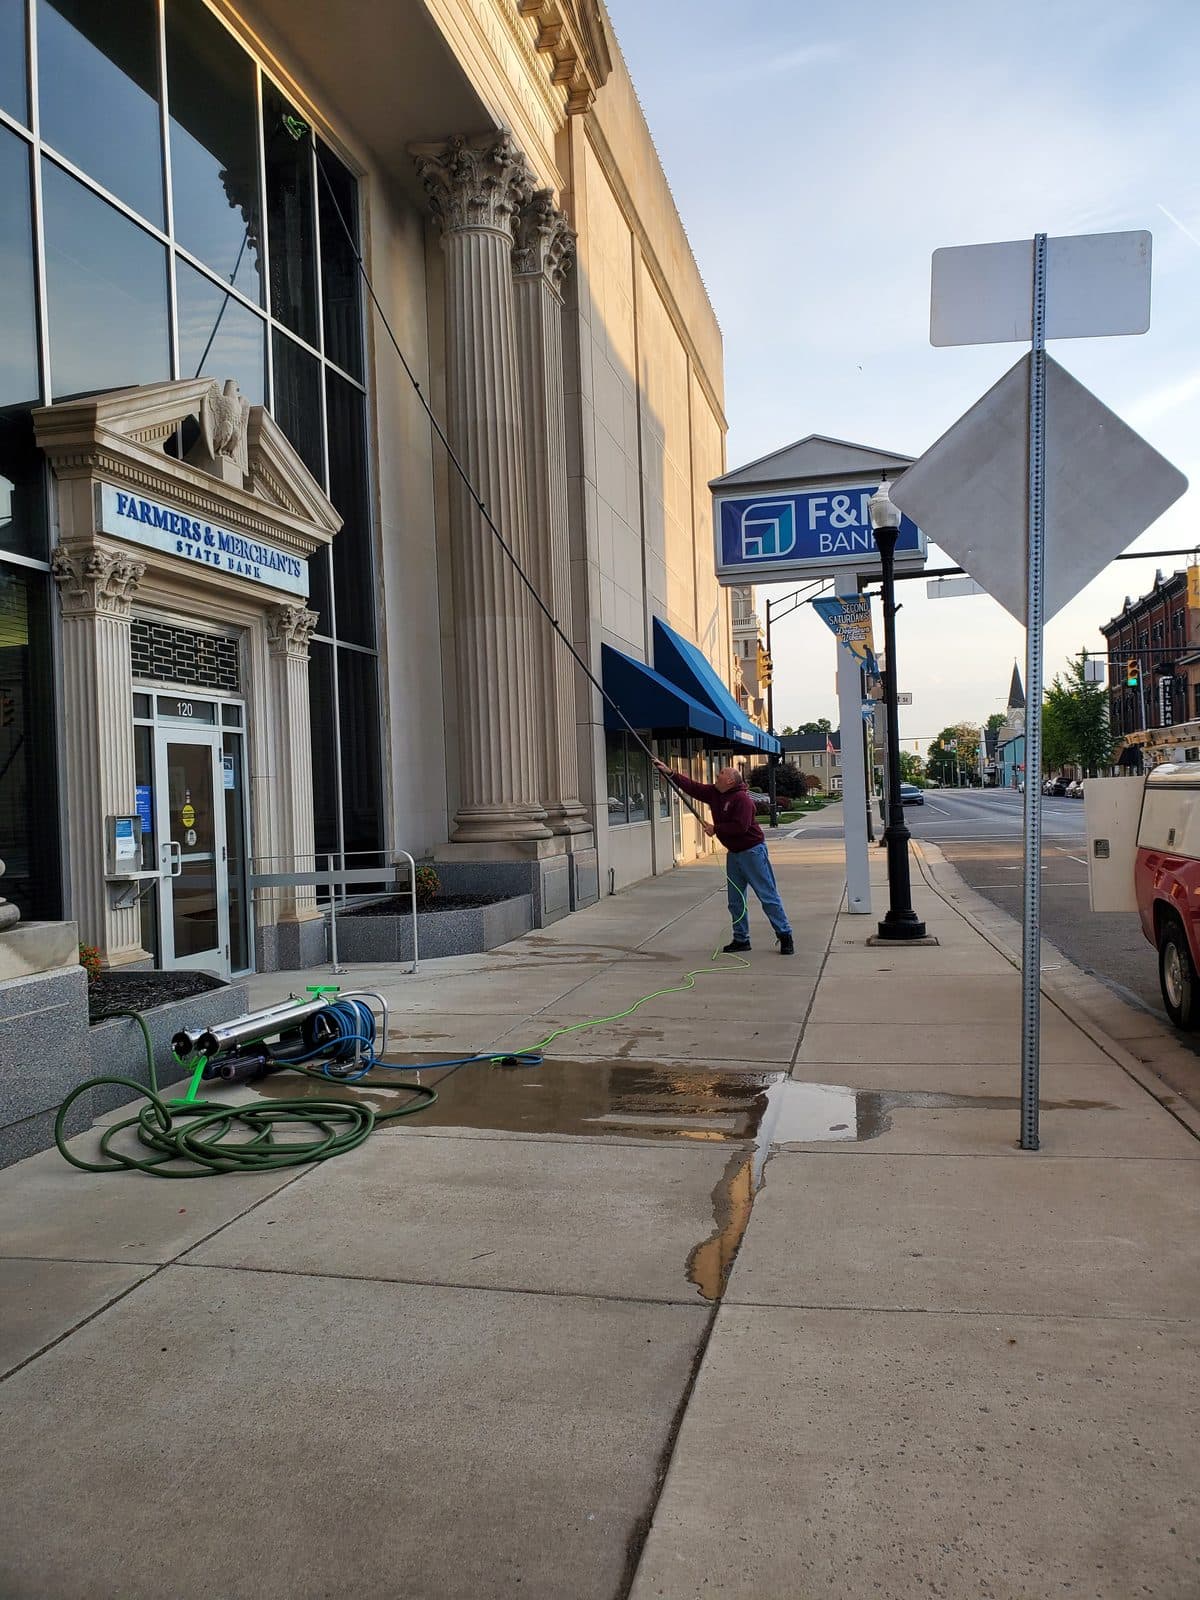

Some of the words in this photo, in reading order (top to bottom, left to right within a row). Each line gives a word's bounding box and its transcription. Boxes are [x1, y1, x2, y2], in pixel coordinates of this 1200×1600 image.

[116, 492, 201, 542] FARMERS
[204, 526, 215, 547] &
[218, 530, 301, 578] MERCHANTS
[176, 540, 221, 565] STATE
[228, 557, 261, 579] BANK
[829, 612, 870, 624] SATURDAYS
[842, 602, 868, 613] SECOND
[176, 702, 193, 717] 120
[1164, 680, 1172, 724] WILLMAN
